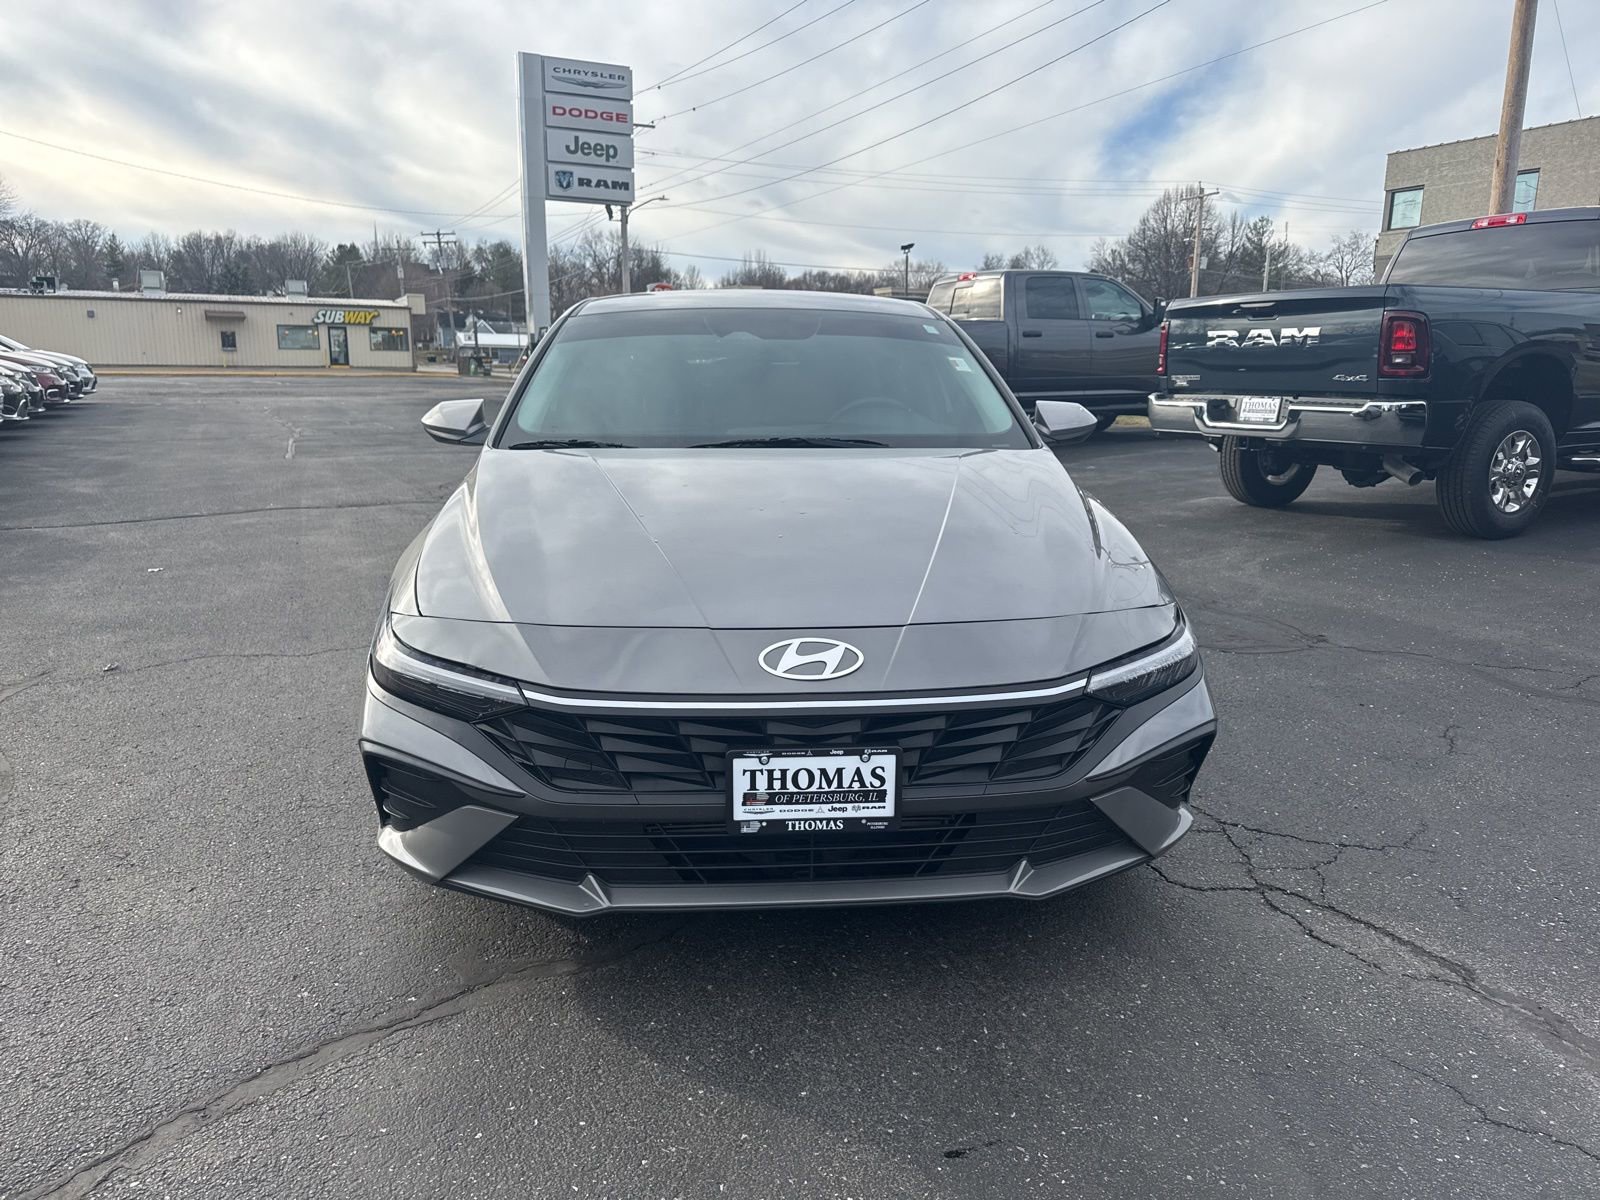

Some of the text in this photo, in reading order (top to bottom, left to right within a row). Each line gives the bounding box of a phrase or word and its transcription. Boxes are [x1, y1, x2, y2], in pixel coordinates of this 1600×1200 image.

[553, 67, 625, 81] CHRYSLER
[552, 105, 628, 123] DODGE
[565, 136, 618, 162] Jeep
[577, 177, 630, 191] RAM
[313, 310, 378, 324] SUBWAY
[1206, 327, 1322, 348] RAM
[1244, 401, 1278, 409] THOMAS
[742, 766, 886, 791] THOMAS
[775, 792, 879, 803] OF PETERSBURG, IL
[828, 805, 848, 813] Jeep
[786, 819, 844, 831] THOMAS
